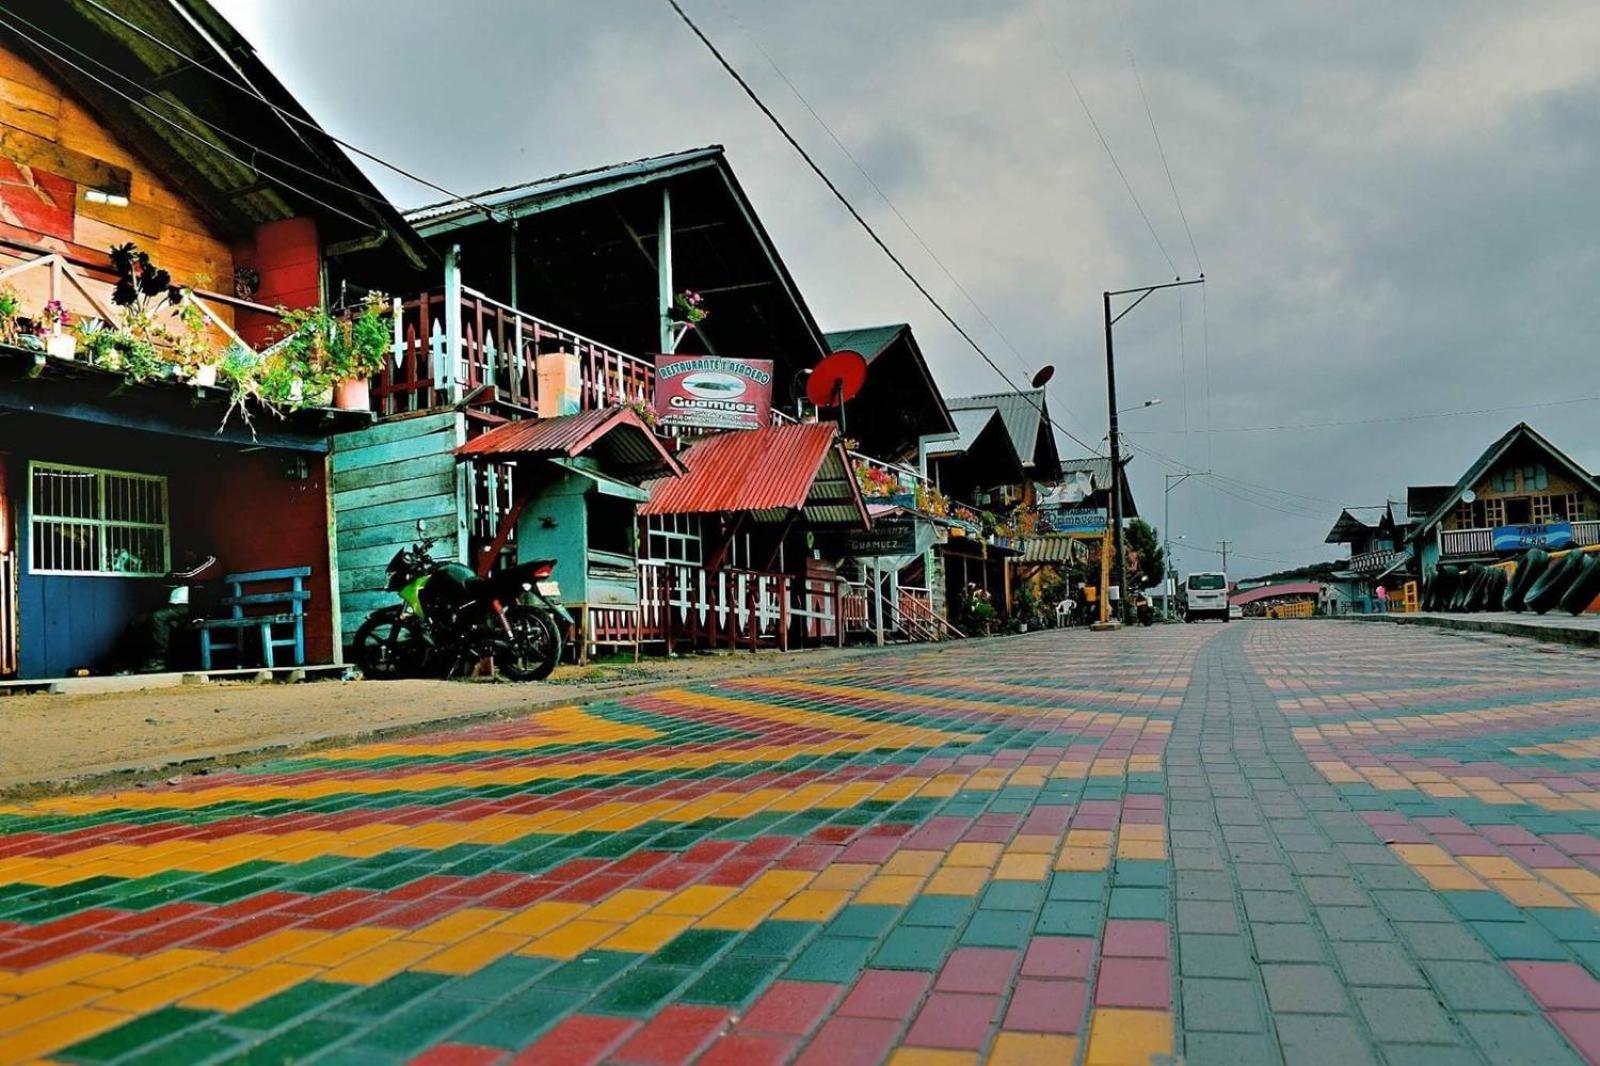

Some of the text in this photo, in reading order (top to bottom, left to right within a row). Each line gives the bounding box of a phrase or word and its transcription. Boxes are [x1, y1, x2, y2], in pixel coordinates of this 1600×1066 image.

[659, 359, 720, 378] RESTAURANTE
[729, 361, 770, 384] ASADERO
[670, 396, 756, 412] Guamuez
